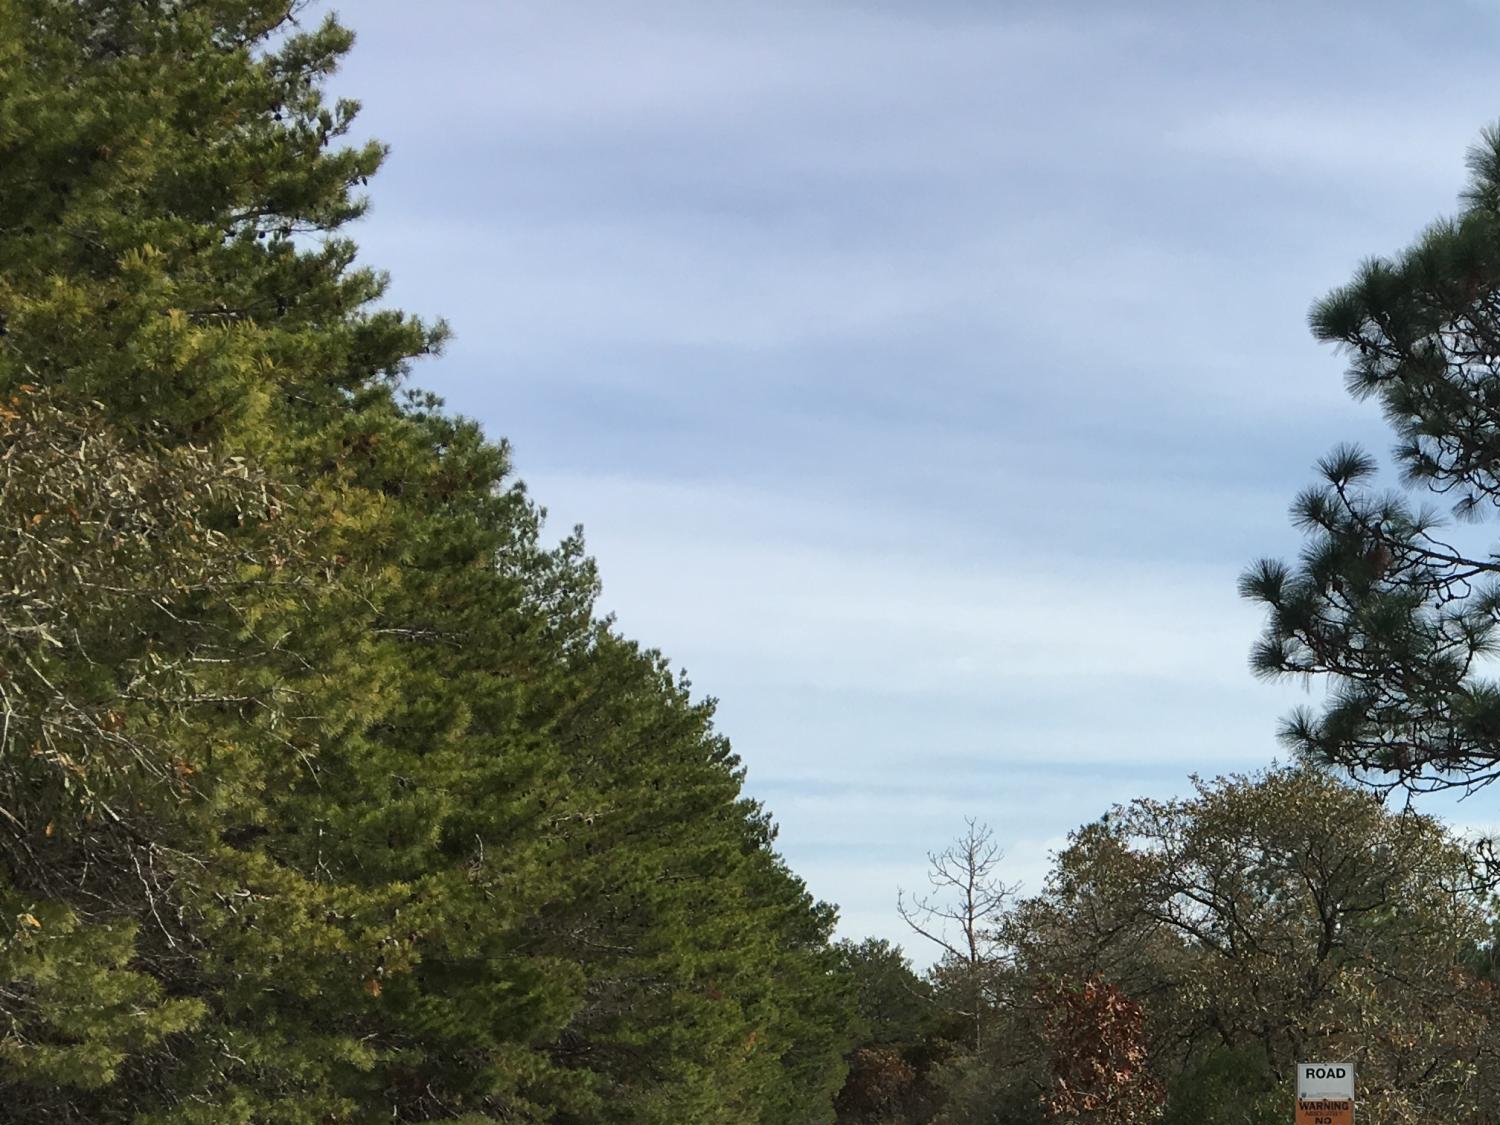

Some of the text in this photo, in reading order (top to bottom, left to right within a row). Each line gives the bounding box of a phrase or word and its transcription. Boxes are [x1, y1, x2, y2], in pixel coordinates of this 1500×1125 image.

[1305, 1068, 1346, 1079] ROAD
[1299, 1101, 1349, 1111] WARNING
[1315, 1117, 1332, 1125] NO
